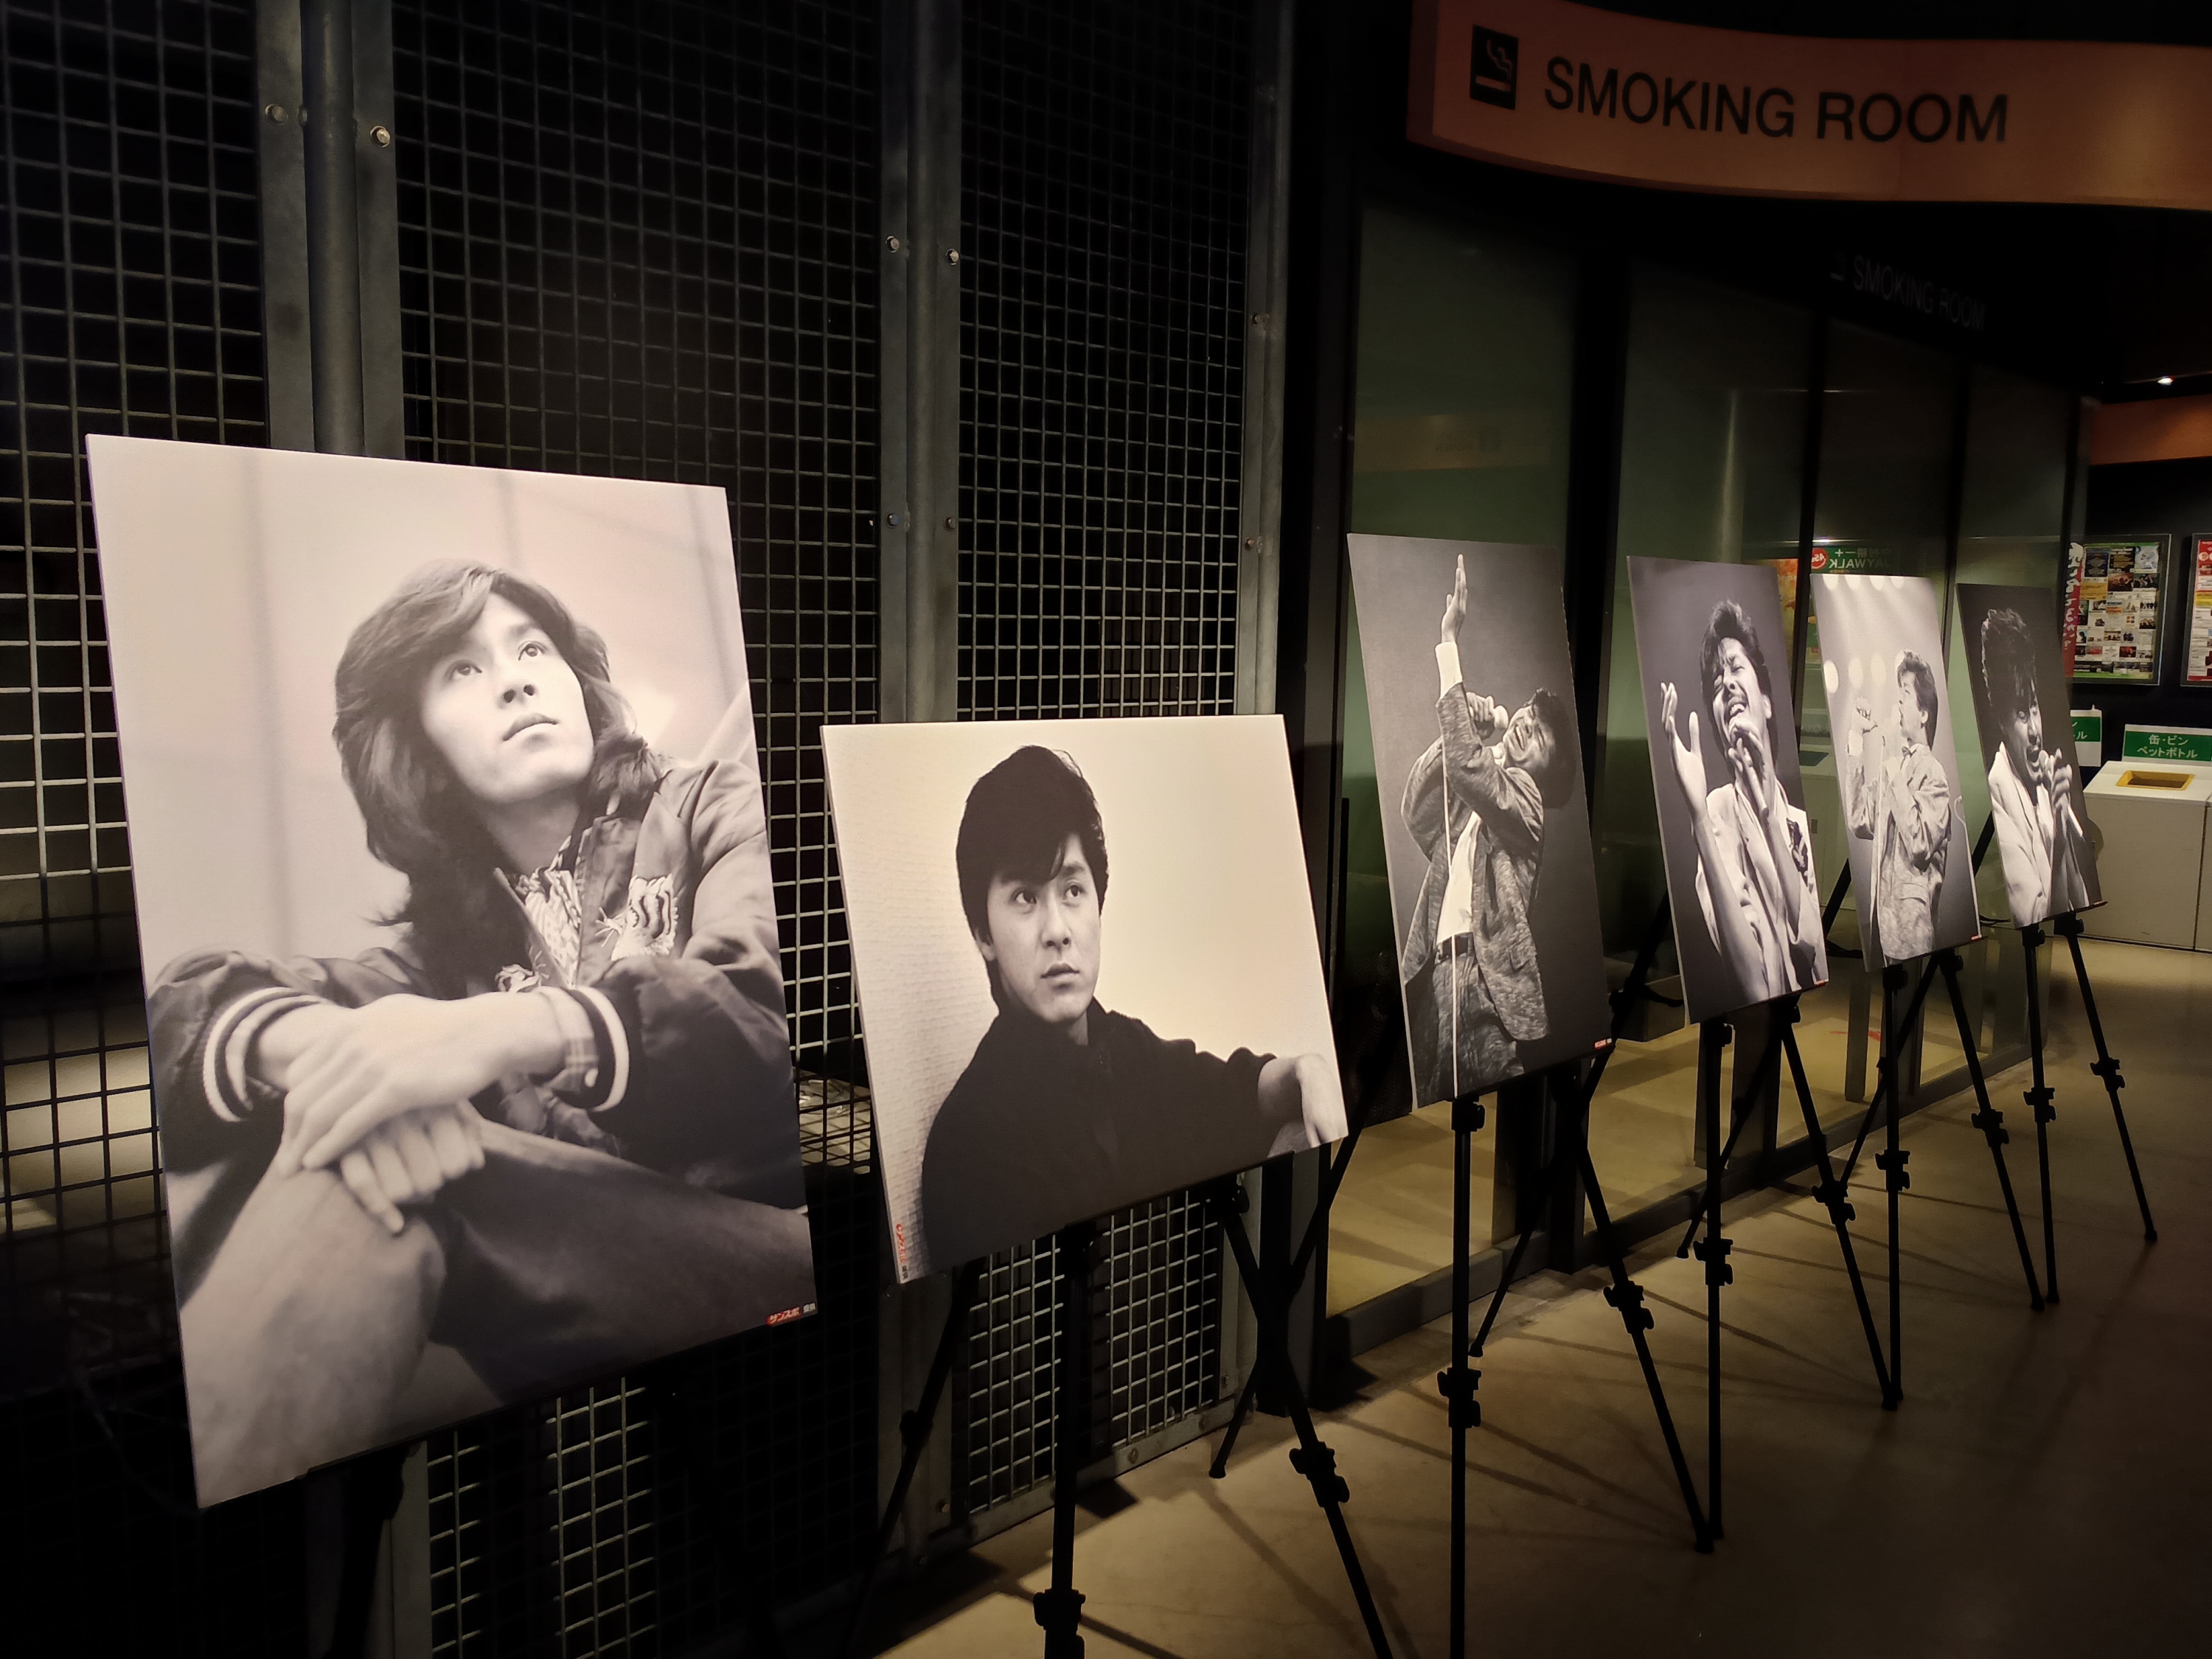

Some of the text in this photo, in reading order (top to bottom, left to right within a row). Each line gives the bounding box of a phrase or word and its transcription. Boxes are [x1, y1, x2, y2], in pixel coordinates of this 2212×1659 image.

[1544, 56, 2008, 142] SMOKING ROOM
[1854, 254, 1985, 330] SMOKING ROOM
[2148, 734, 2188, 745] 缶・ビン
[2137, 745, 2198, 759] ペットボトル
[769, 1307, 800, 1324] サンスポ
